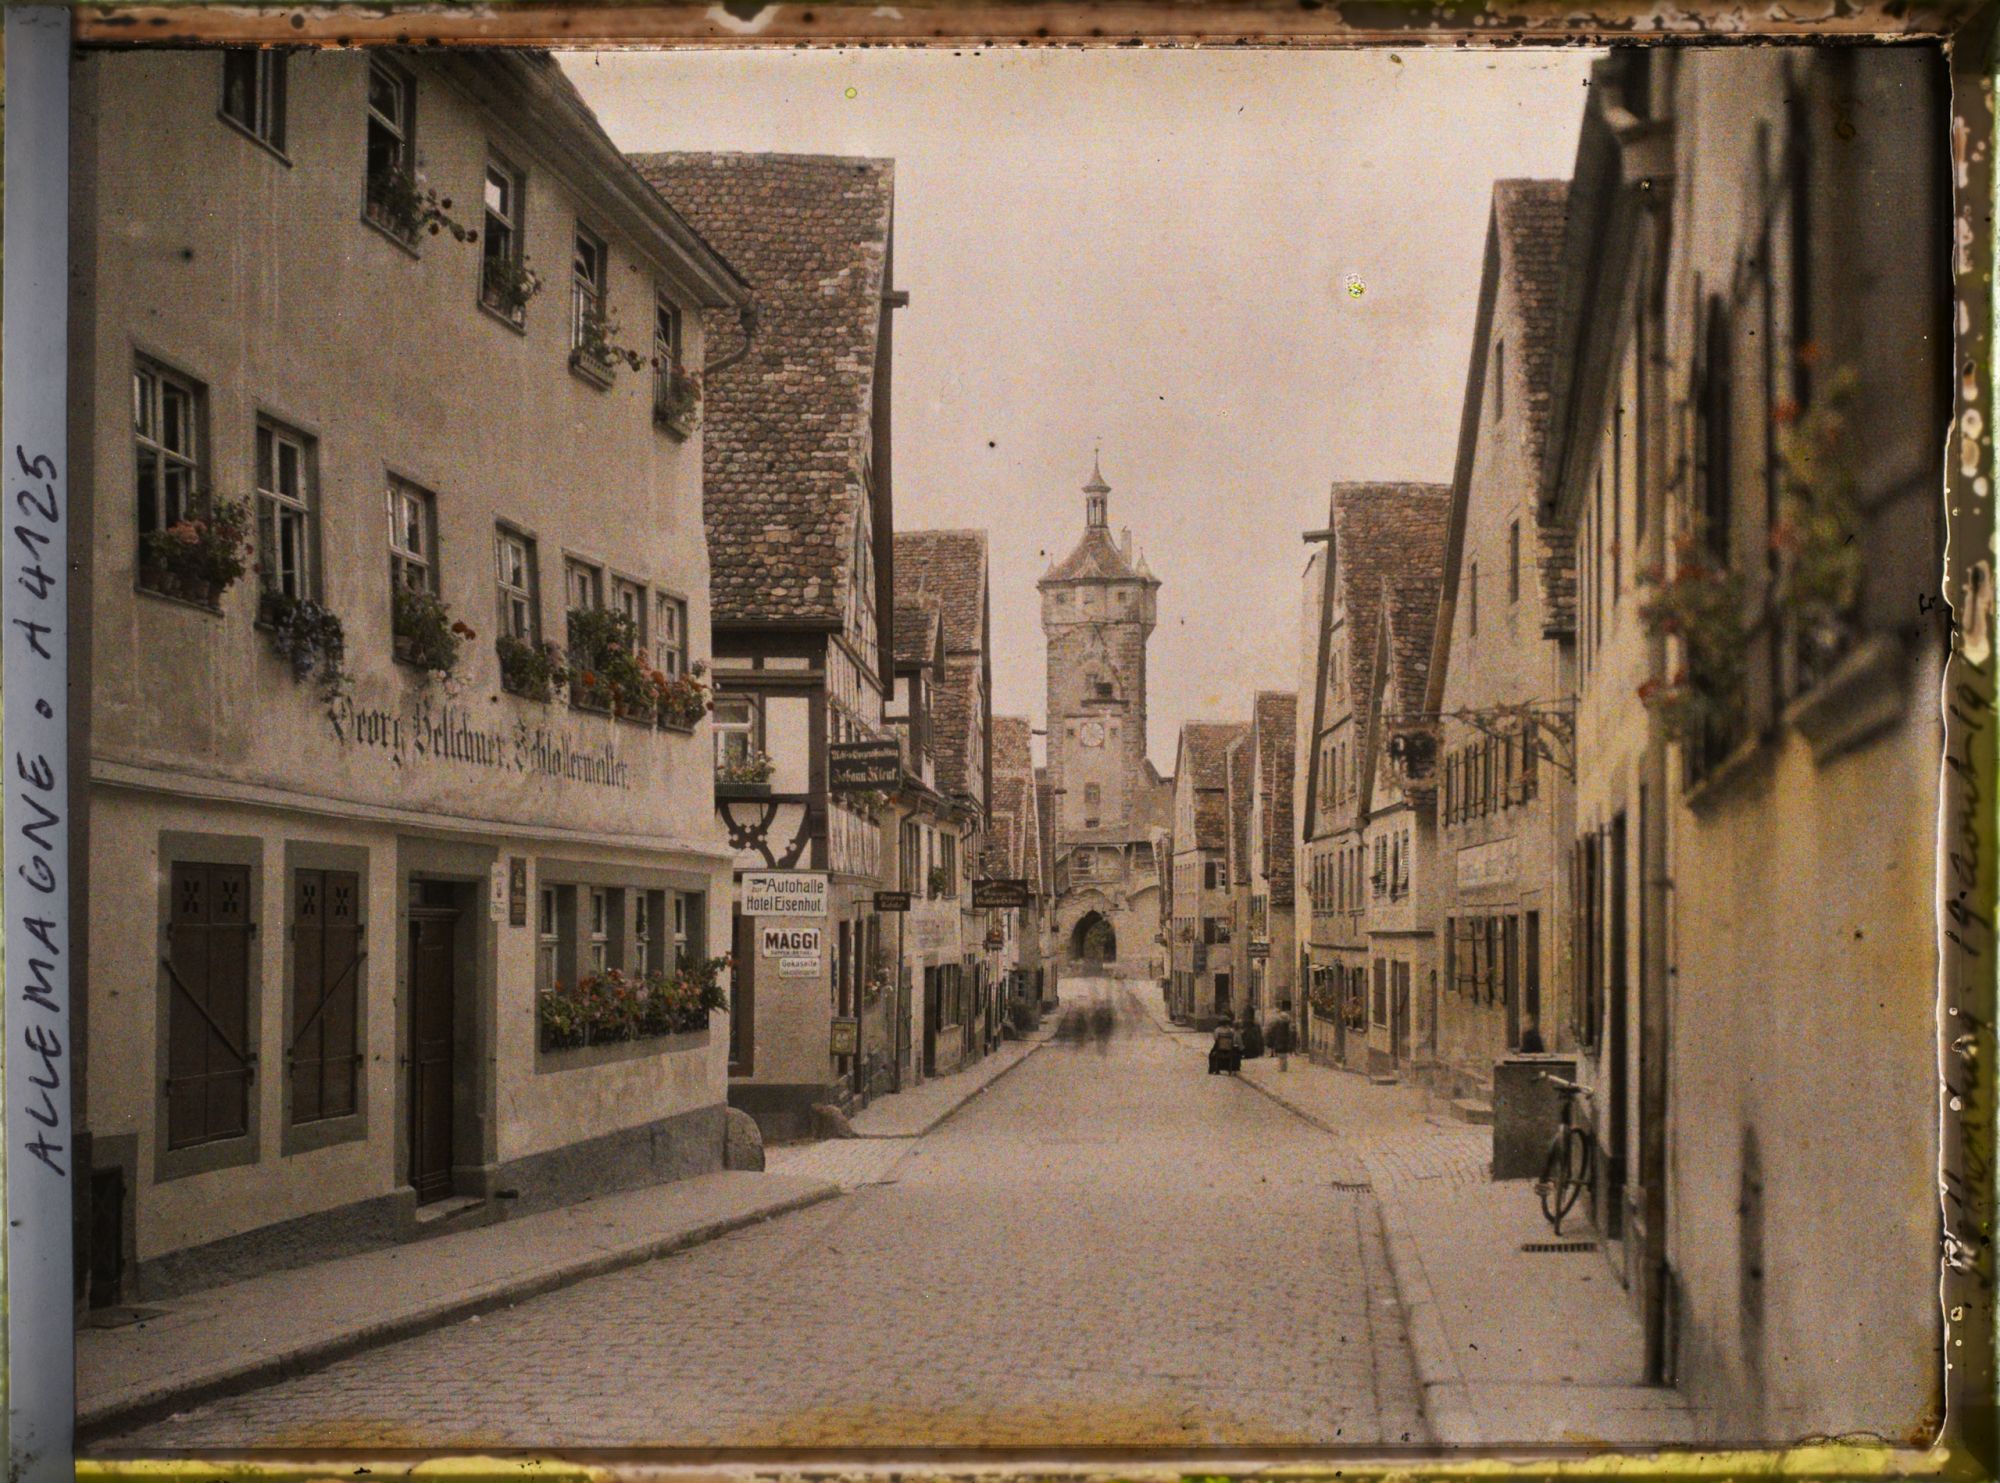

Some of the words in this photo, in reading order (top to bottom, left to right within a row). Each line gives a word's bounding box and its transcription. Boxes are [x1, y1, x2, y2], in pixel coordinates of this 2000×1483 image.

[766, 878, 825, 894] Autohalle
[747, 895, 773, 911] Hotel
[765, 932, 819, 950] MAGGI
[17, 751, 65, 1178] ALLEMAGNE
